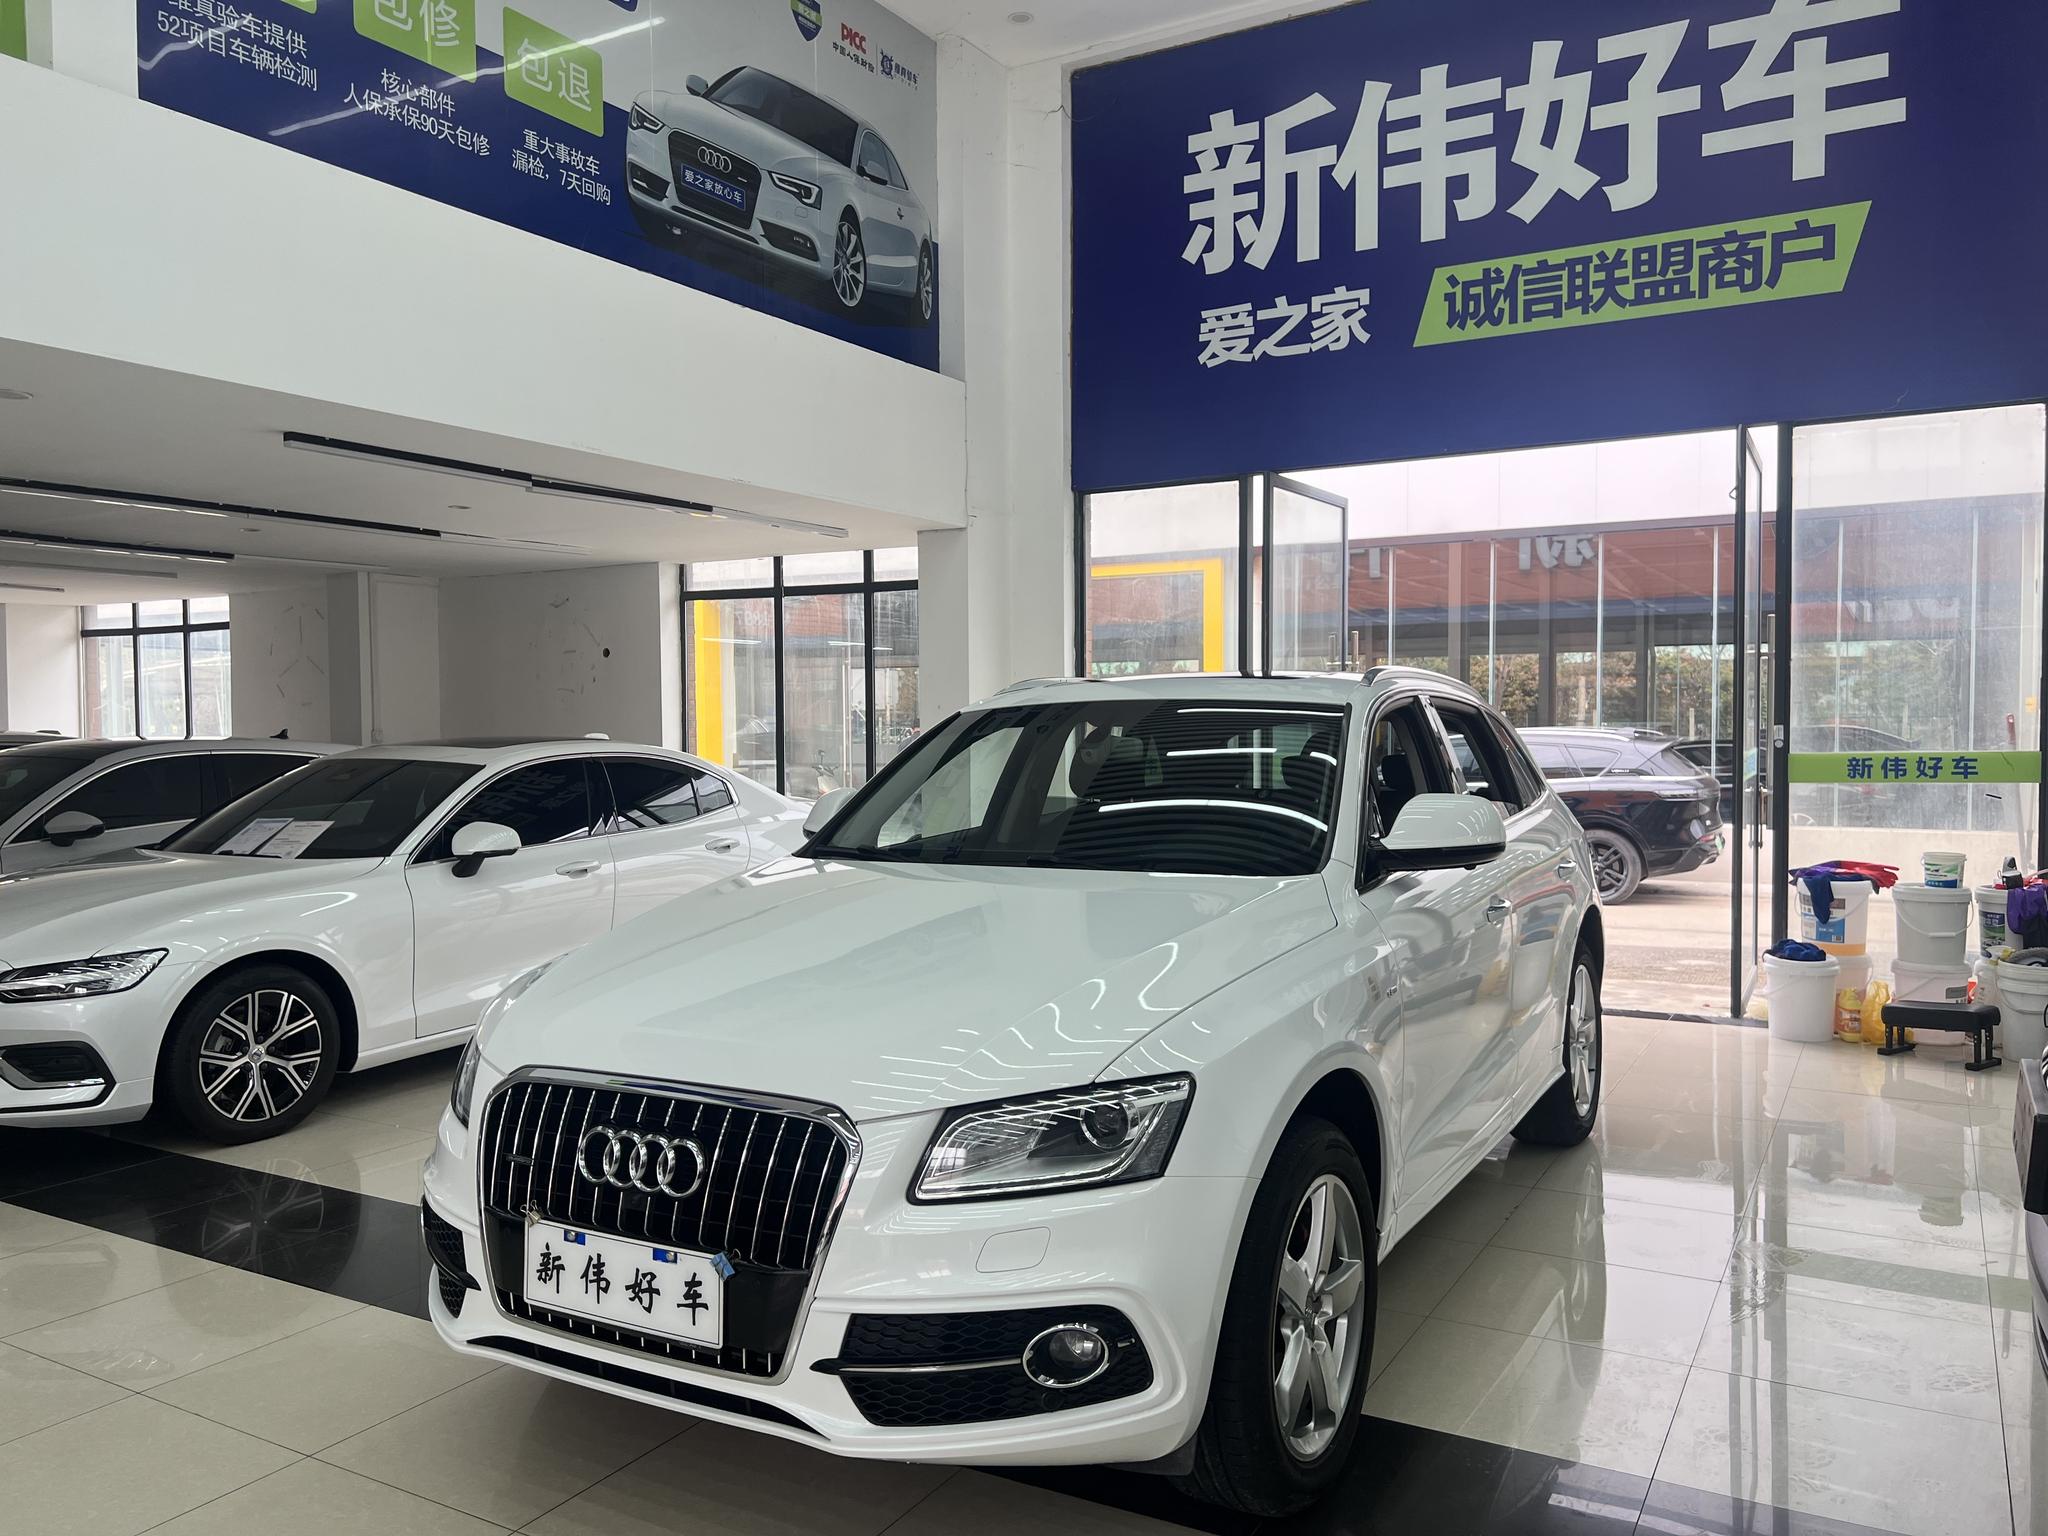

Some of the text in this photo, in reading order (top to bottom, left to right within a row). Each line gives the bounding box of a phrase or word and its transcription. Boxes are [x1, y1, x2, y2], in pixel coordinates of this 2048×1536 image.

[157, 10, 317, 92] 52项目车辆检测
[517, 37, 592, 112] 包退
[841, 22, 867, 54] PICC
[344, 82, 490, 157] 人保承保90天包修
[381, 68, 456, 117] 核心部件
[523, 128, 601, 177] 重大事故车
[1181, 0, 1908, 275] 新伟好车
[684, 169, 742, 203] 爱之家放心车
[1443, 218, 1837, 332] 诚信联盟商户
[1198, 286, 1372, 368] 爱之家
[1846, 755, 1979, 780] 新伟好车
[535, 1242, 710, 1326] 新伟好车
